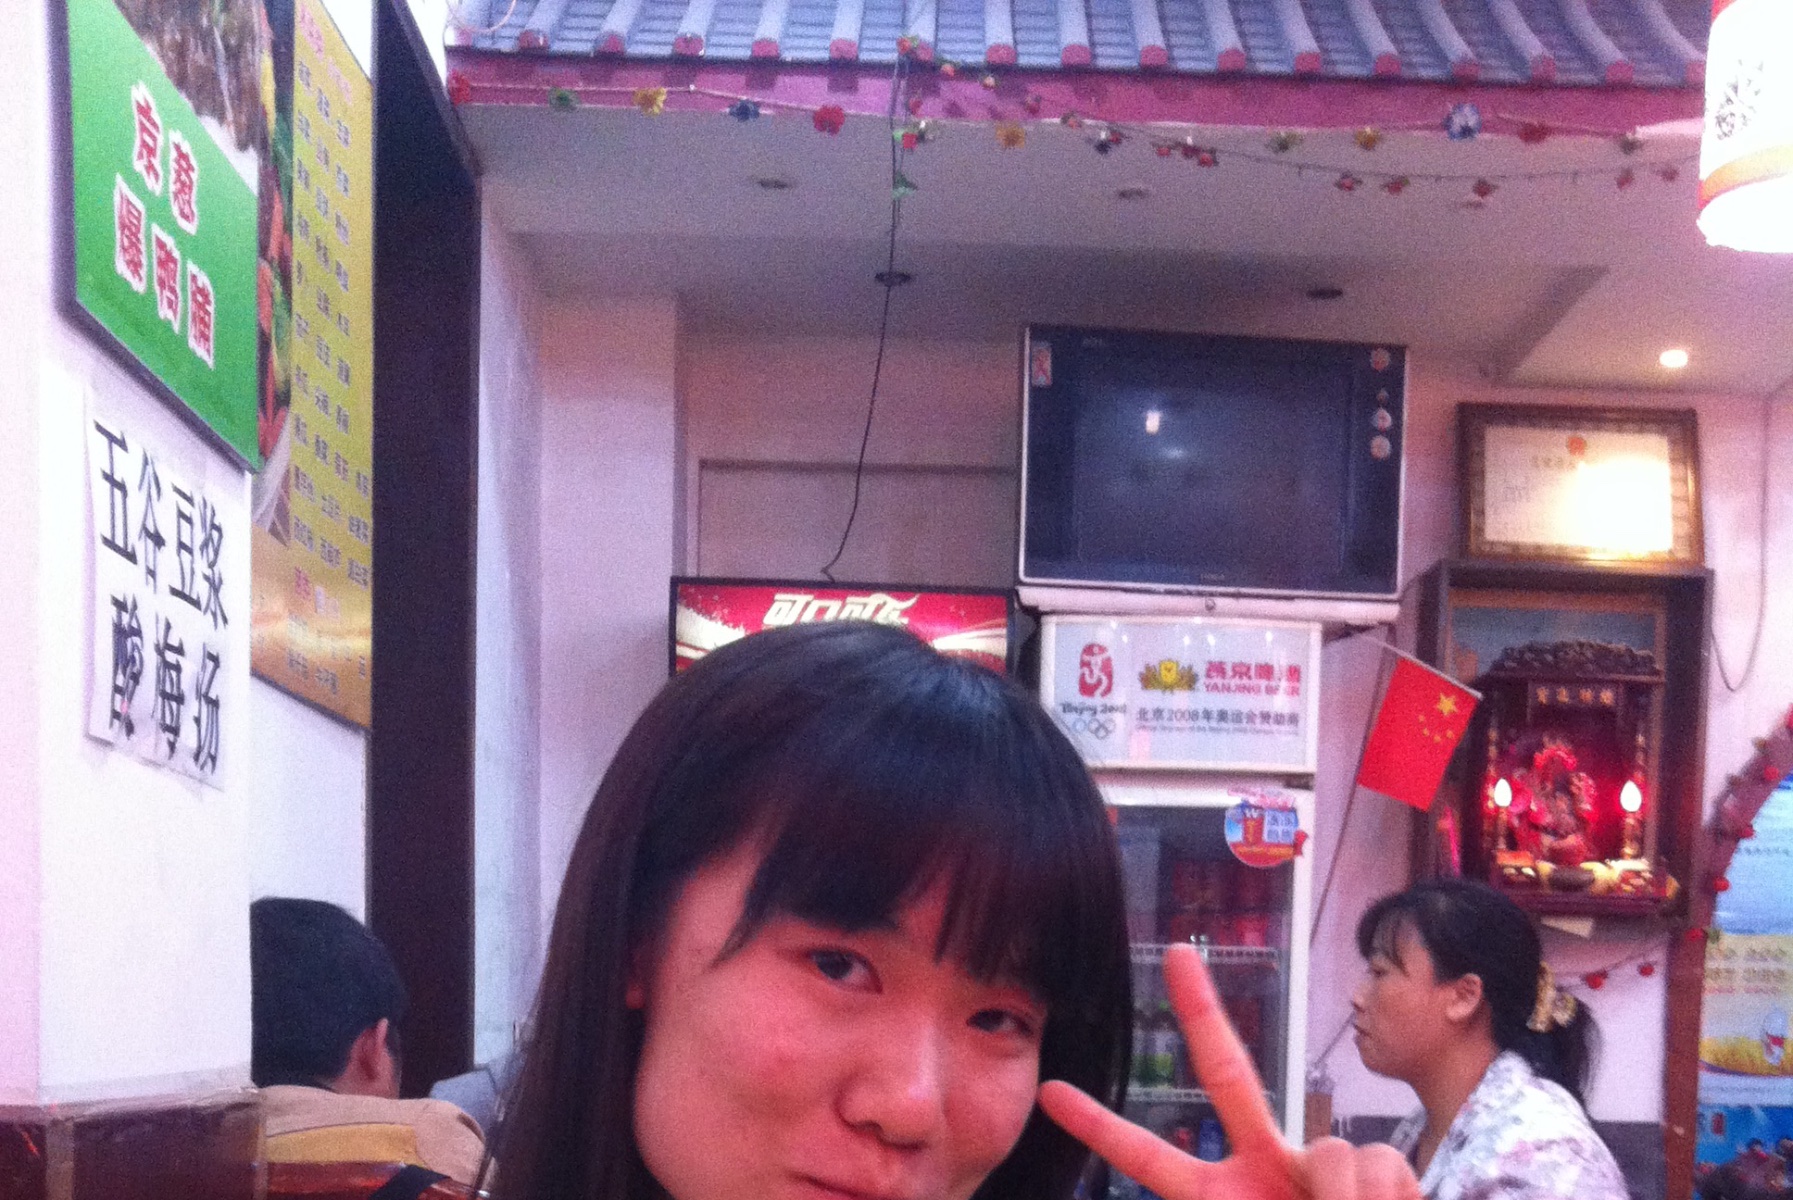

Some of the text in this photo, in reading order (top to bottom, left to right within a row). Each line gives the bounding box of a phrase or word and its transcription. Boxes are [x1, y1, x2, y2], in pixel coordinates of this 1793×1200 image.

[133, 84, 198, 233] 京葱
[94, 419, 229, 631] 五谷豆浆
[109, 592, 221, 776] 酸梅汤
